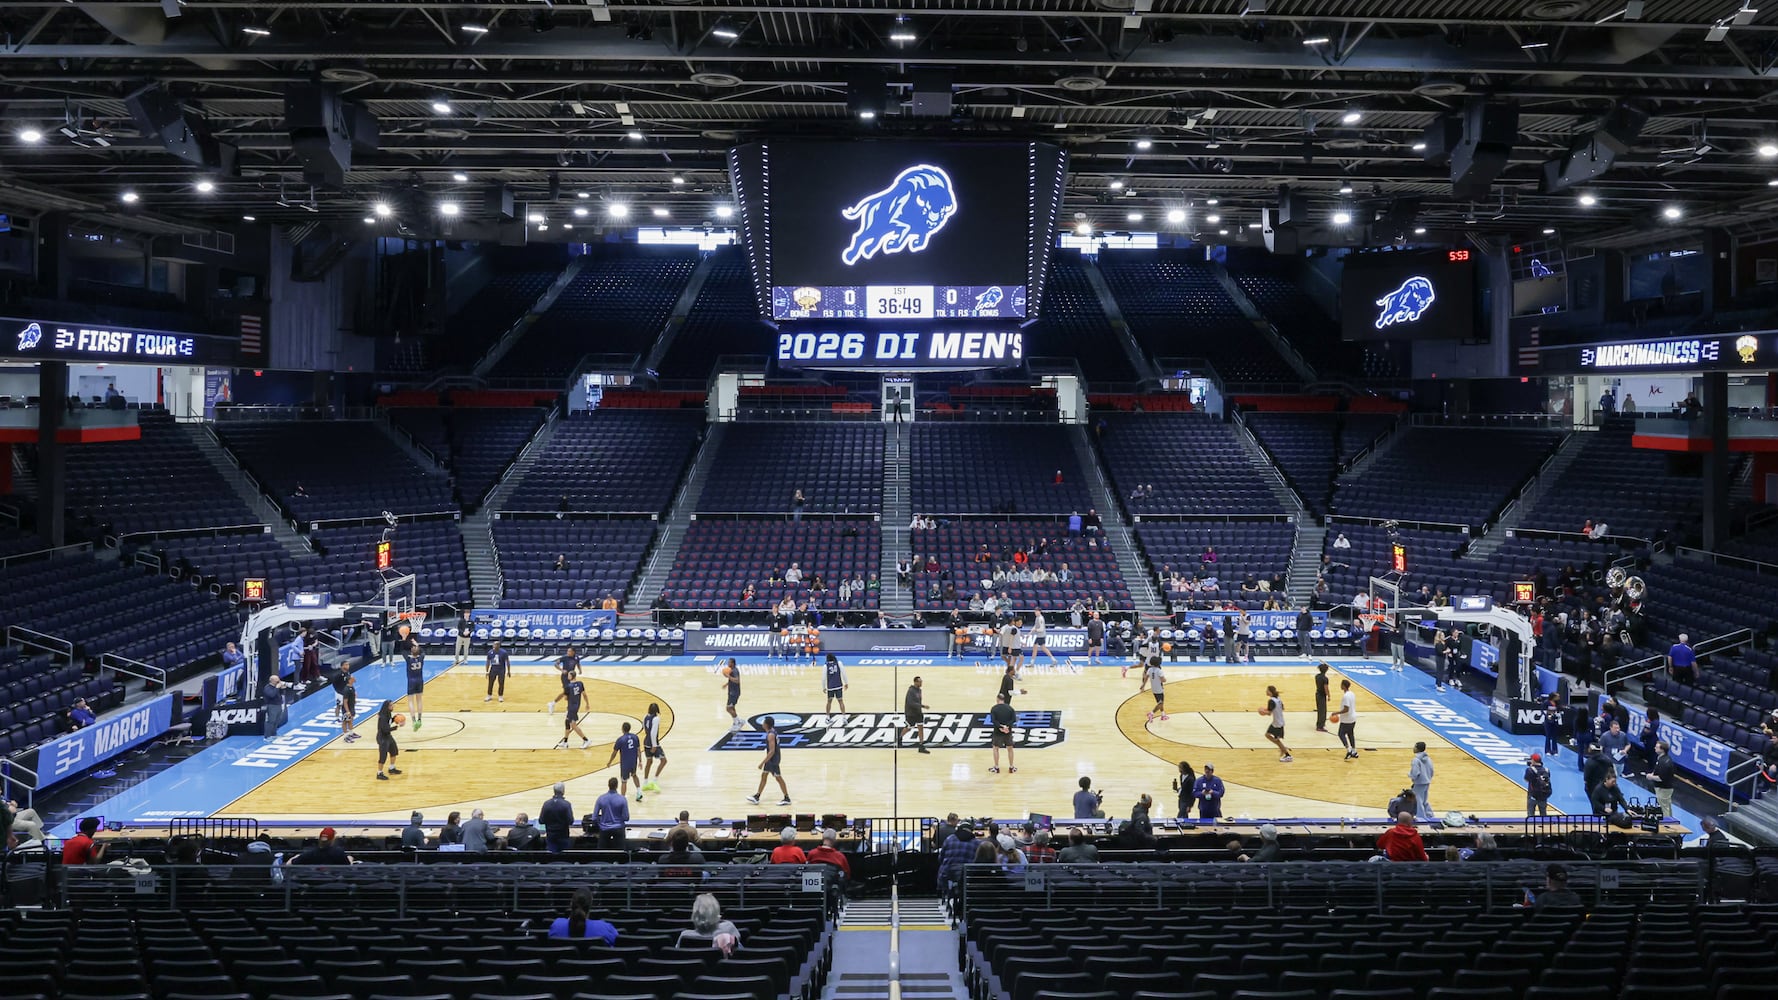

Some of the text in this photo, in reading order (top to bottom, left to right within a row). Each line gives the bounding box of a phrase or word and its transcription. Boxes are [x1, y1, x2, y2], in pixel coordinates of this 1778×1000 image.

[1449, 250, 1469, 261] 5:53
[844, 289, 856, 305] 0
[893, 287, 906, 295] 1ST
[946, 288, 957, 305] 0
[878, 298, 921, 314] 36:49
[958, 309, 969, 317] FLS
[979, 309, 999, 317] BONUS
[77, 329, 177, 355] FIRST FOUR
[778, 332, 1022, 360] 2026 DI MEN'S
[1595, 340, 1700, 367] MARCHMADNESS
[379, 551, 388, 568] 30
[1395, 555, 1404, 571] 30
[248, 588, 260, 597] 30
[1519, 591, 1530, 600] 30
[526, 614, 554, 626] FINAL
[556, 614, 585, 626] FOUR
[411, 662, 422, 671] 33
[858, 658, 934, 666] DAYTON
[829, 665, 839, 675] 34
[573, 686, 581, 696] 12
[209, 708, 257, 725] NCAA
[801, 713, 974, 728] MARCH
[1393, 697, 1484, 731] FIRST
[94, 707, 150, 758] MARCH
[231, 728, 331, 768] FIRST
[627, 739, 634, 749] 2
[804, 878, 820, 886] 105
